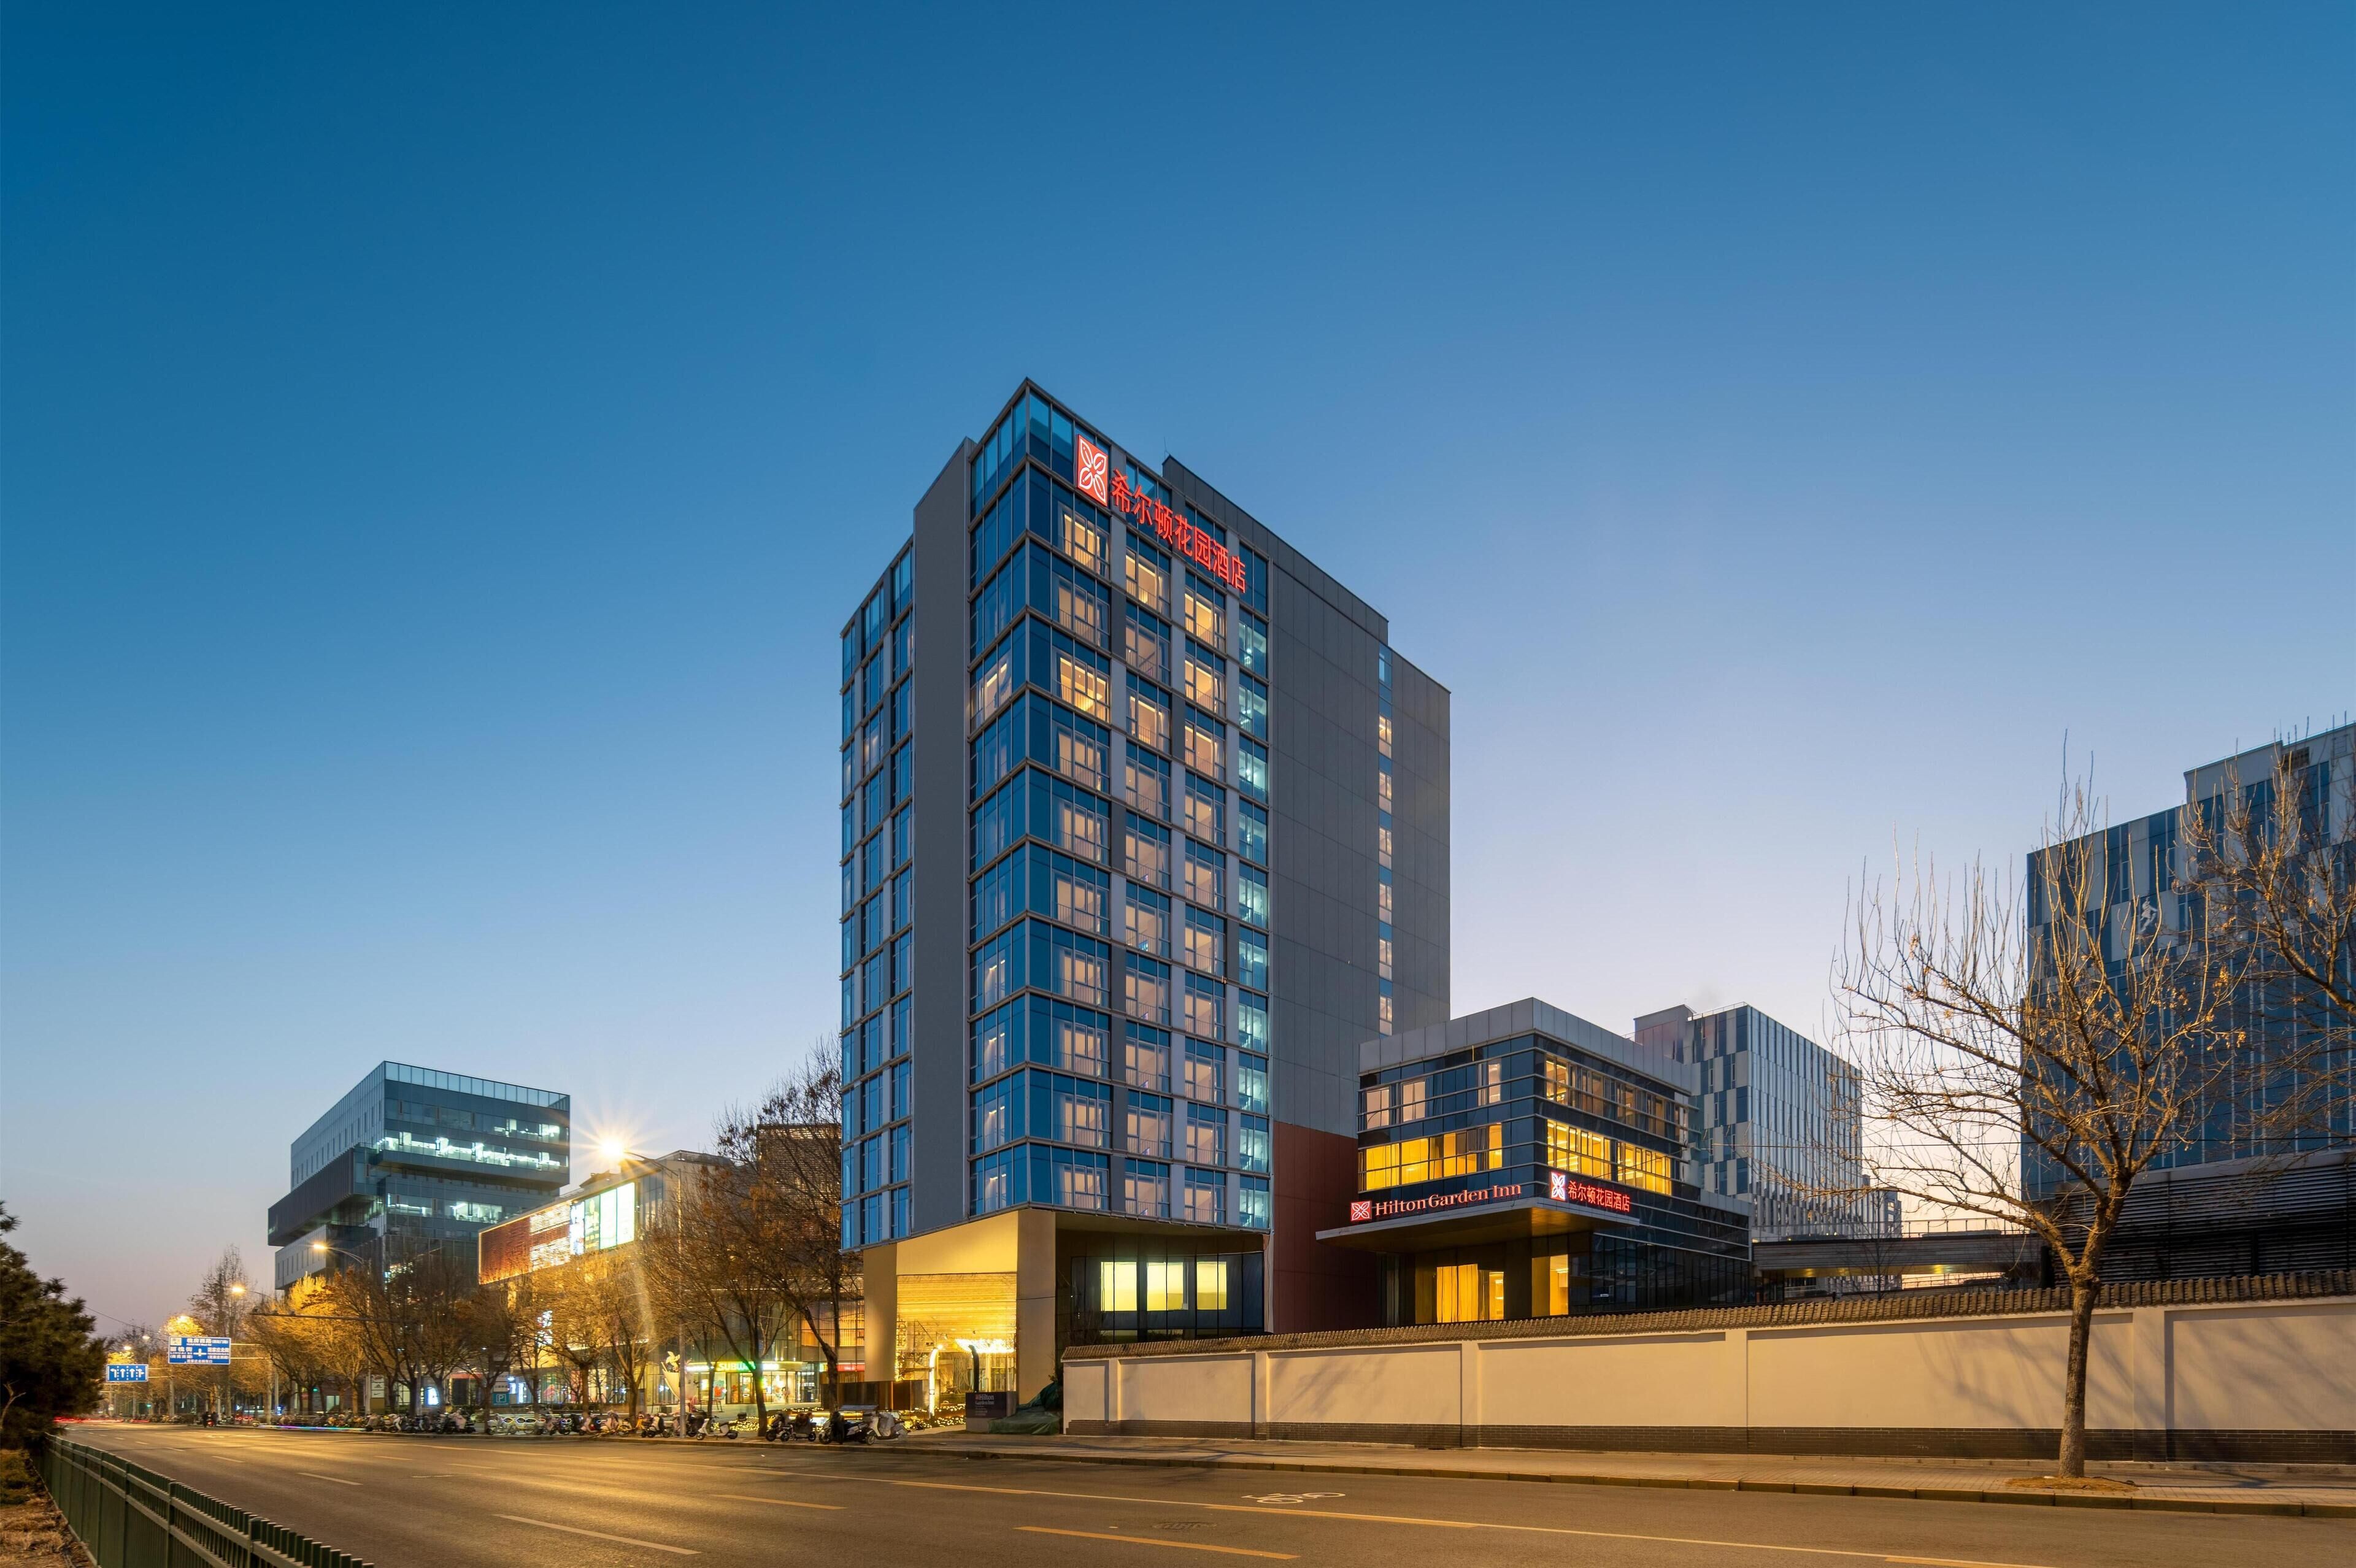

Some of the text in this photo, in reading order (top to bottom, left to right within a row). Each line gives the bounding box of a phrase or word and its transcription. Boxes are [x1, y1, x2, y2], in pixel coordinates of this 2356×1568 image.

[1111, 468, 1245, 594] 希尔顿花园酒店
[1375, 1184, 1522, 1216] Hilton Garden Inn
[1568, 1180, 1630, 1212] 希尔顿花园酒店
